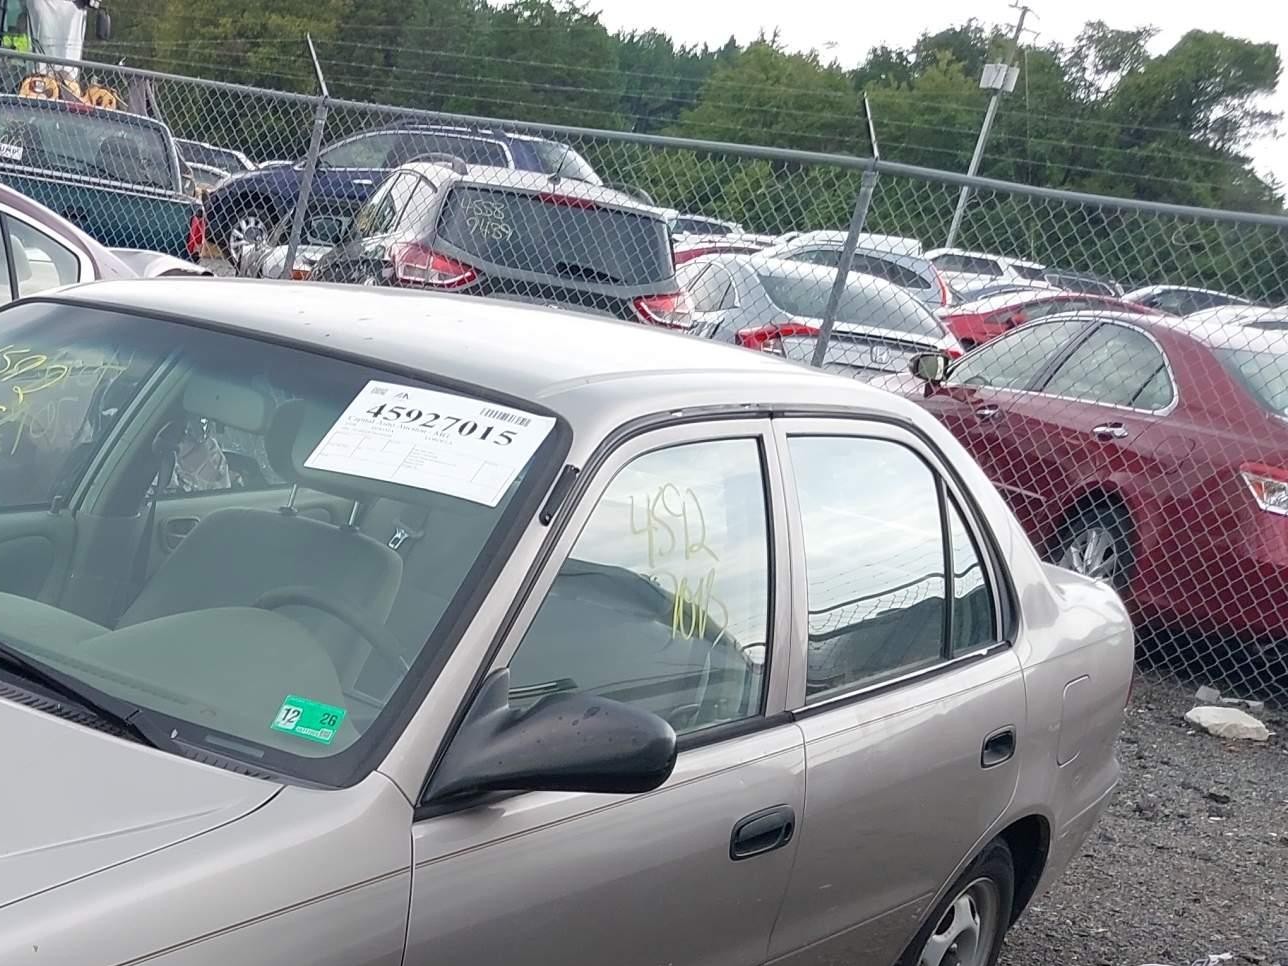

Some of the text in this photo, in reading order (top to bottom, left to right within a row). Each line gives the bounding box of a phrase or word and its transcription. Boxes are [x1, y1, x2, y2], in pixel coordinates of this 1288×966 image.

[366, 402, 518, 446] 45927015
[280, 707, 301, 724] 12
[319, 713, 339, 727] 26
